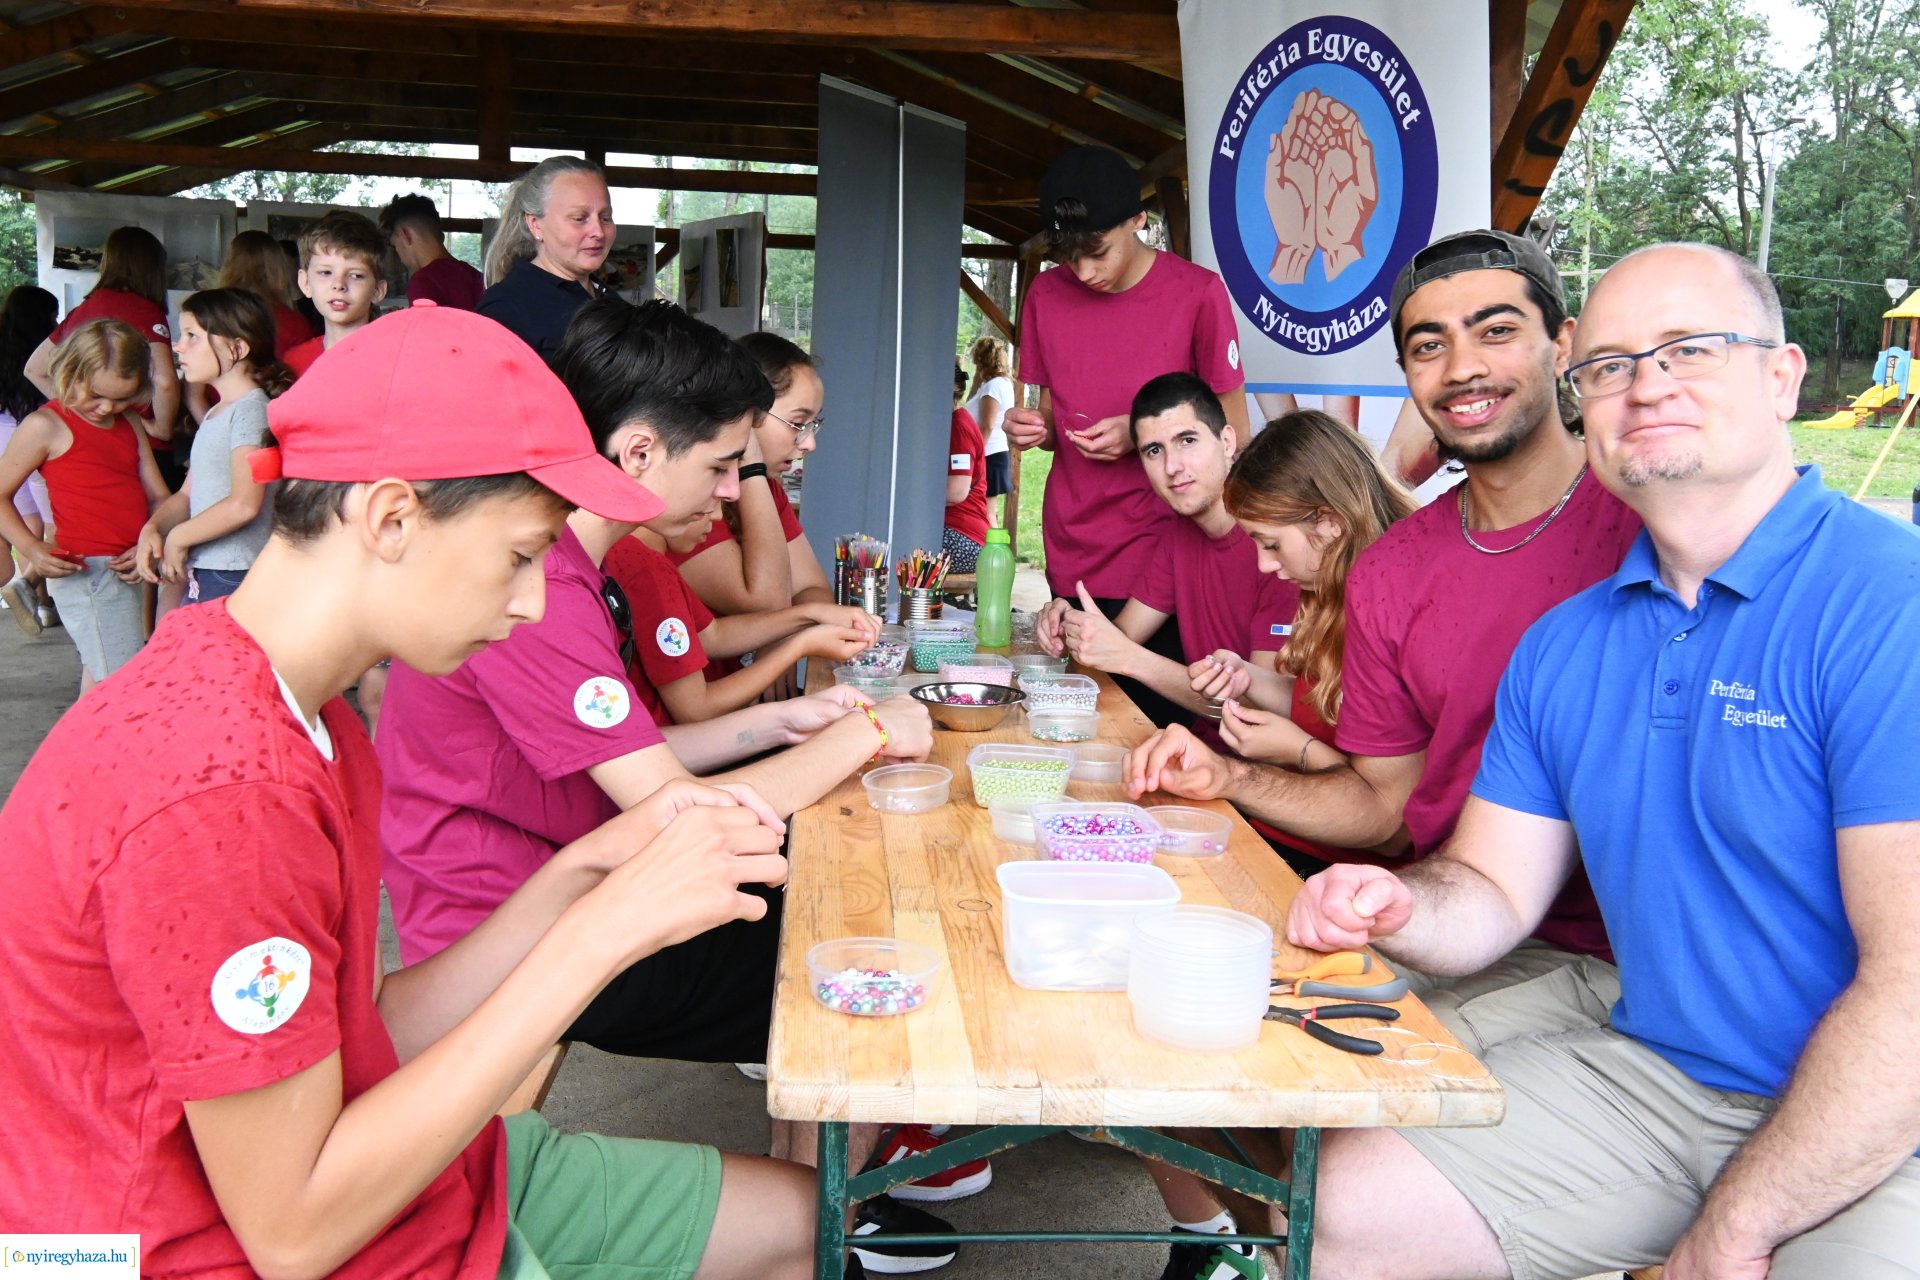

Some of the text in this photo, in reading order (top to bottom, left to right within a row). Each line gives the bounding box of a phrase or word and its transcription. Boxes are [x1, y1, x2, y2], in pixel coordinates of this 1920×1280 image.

[1219, 41, 1302, 160] Periféria
[1307, 28, 1421, 130] Egyesület
[1252, 294, 1388, 353] Nyíregyháza
[264, 979, 275, 993] 16
